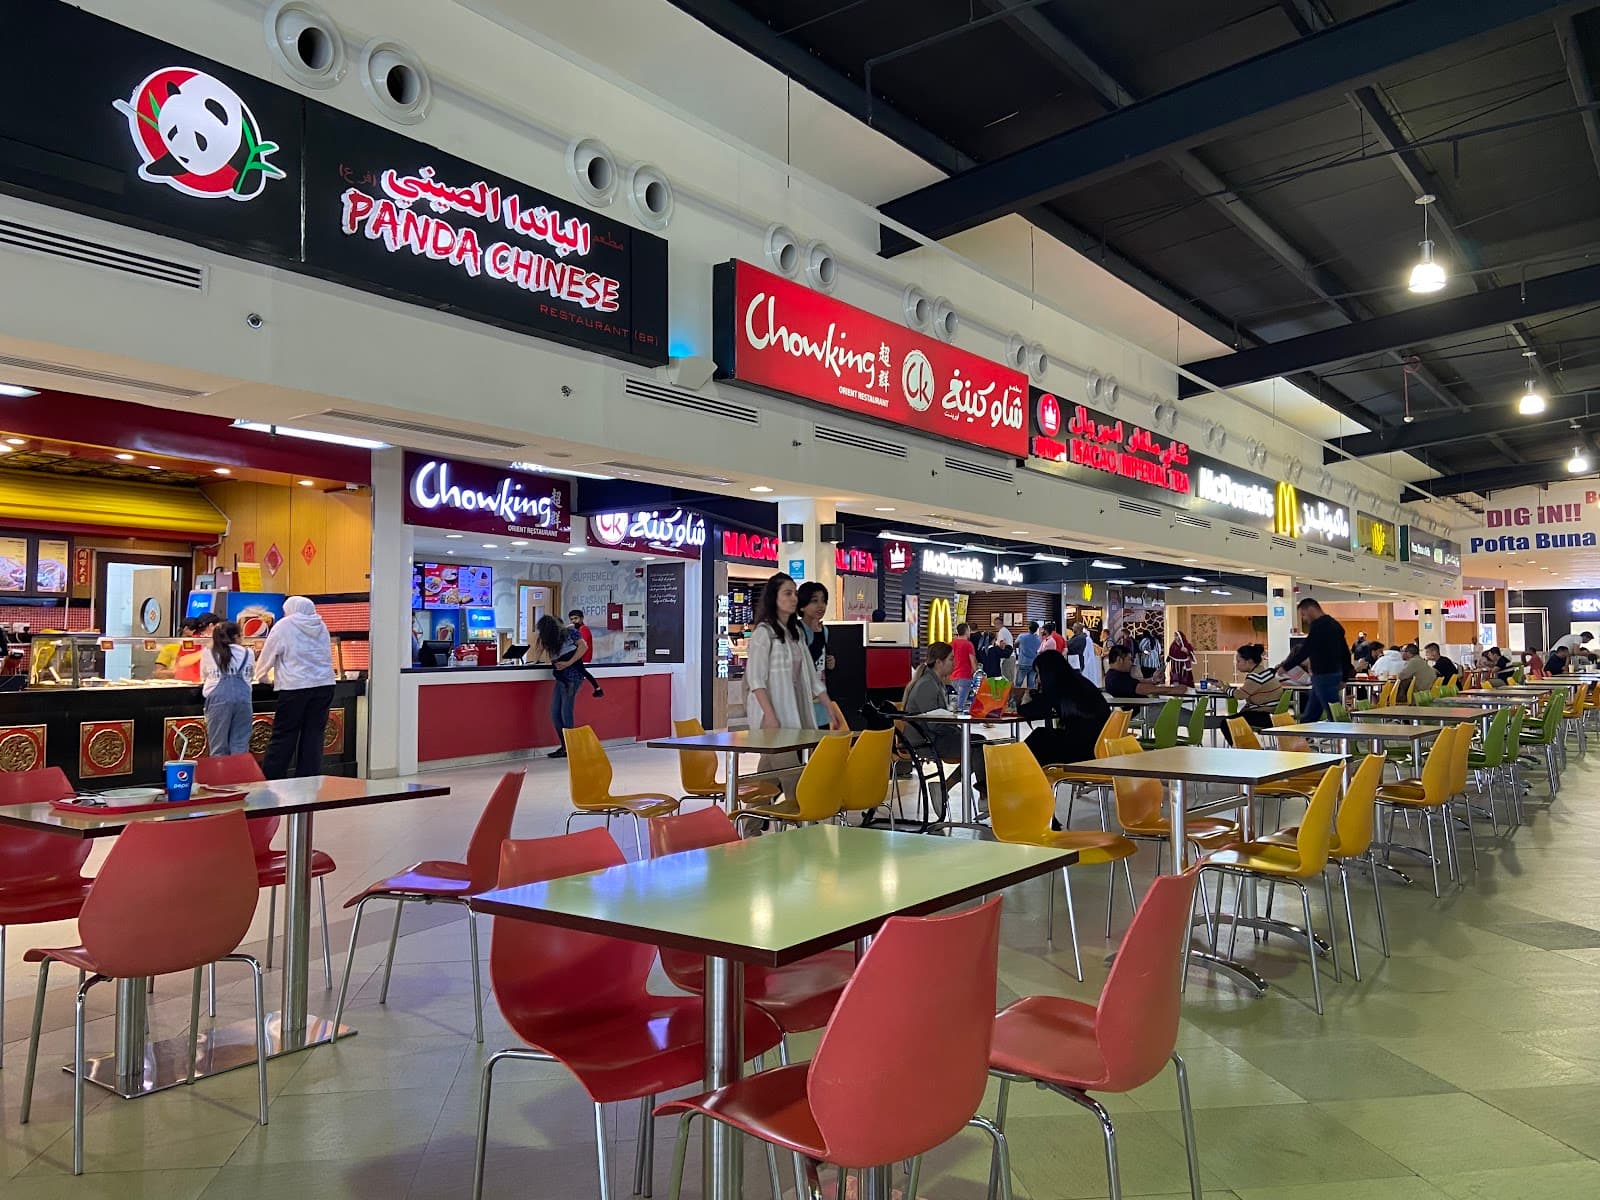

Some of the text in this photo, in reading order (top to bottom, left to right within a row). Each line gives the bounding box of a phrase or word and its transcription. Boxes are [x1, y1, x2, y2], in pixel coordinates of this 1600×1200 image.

[381, 166, 500, 223] الصيني
[341, 187, 620, 313] PANDA CHINESE
[503, 194, 591, 257] الباندا
[538, 303, 659, 346] RESTAURANT (BR)
[745, 292, 875, 389] Chowking
[838, 385, 889, 408] ORIENT RESTAURANT
[1069, 437, 1119, 475] MACAO
[1119, 452, 1169, 489] IMPERIAL
[1168, 468, 1191, 495] TEA
[413, 461, 552, 528] Chowking
[1486, 507, 1531, 528] DIG
[507, 525, 558, 538] ORIENT RESTAURANT
[1470, 532, 1597, 554] Pofta Buna
[849, 549, 875, 573] TEA
